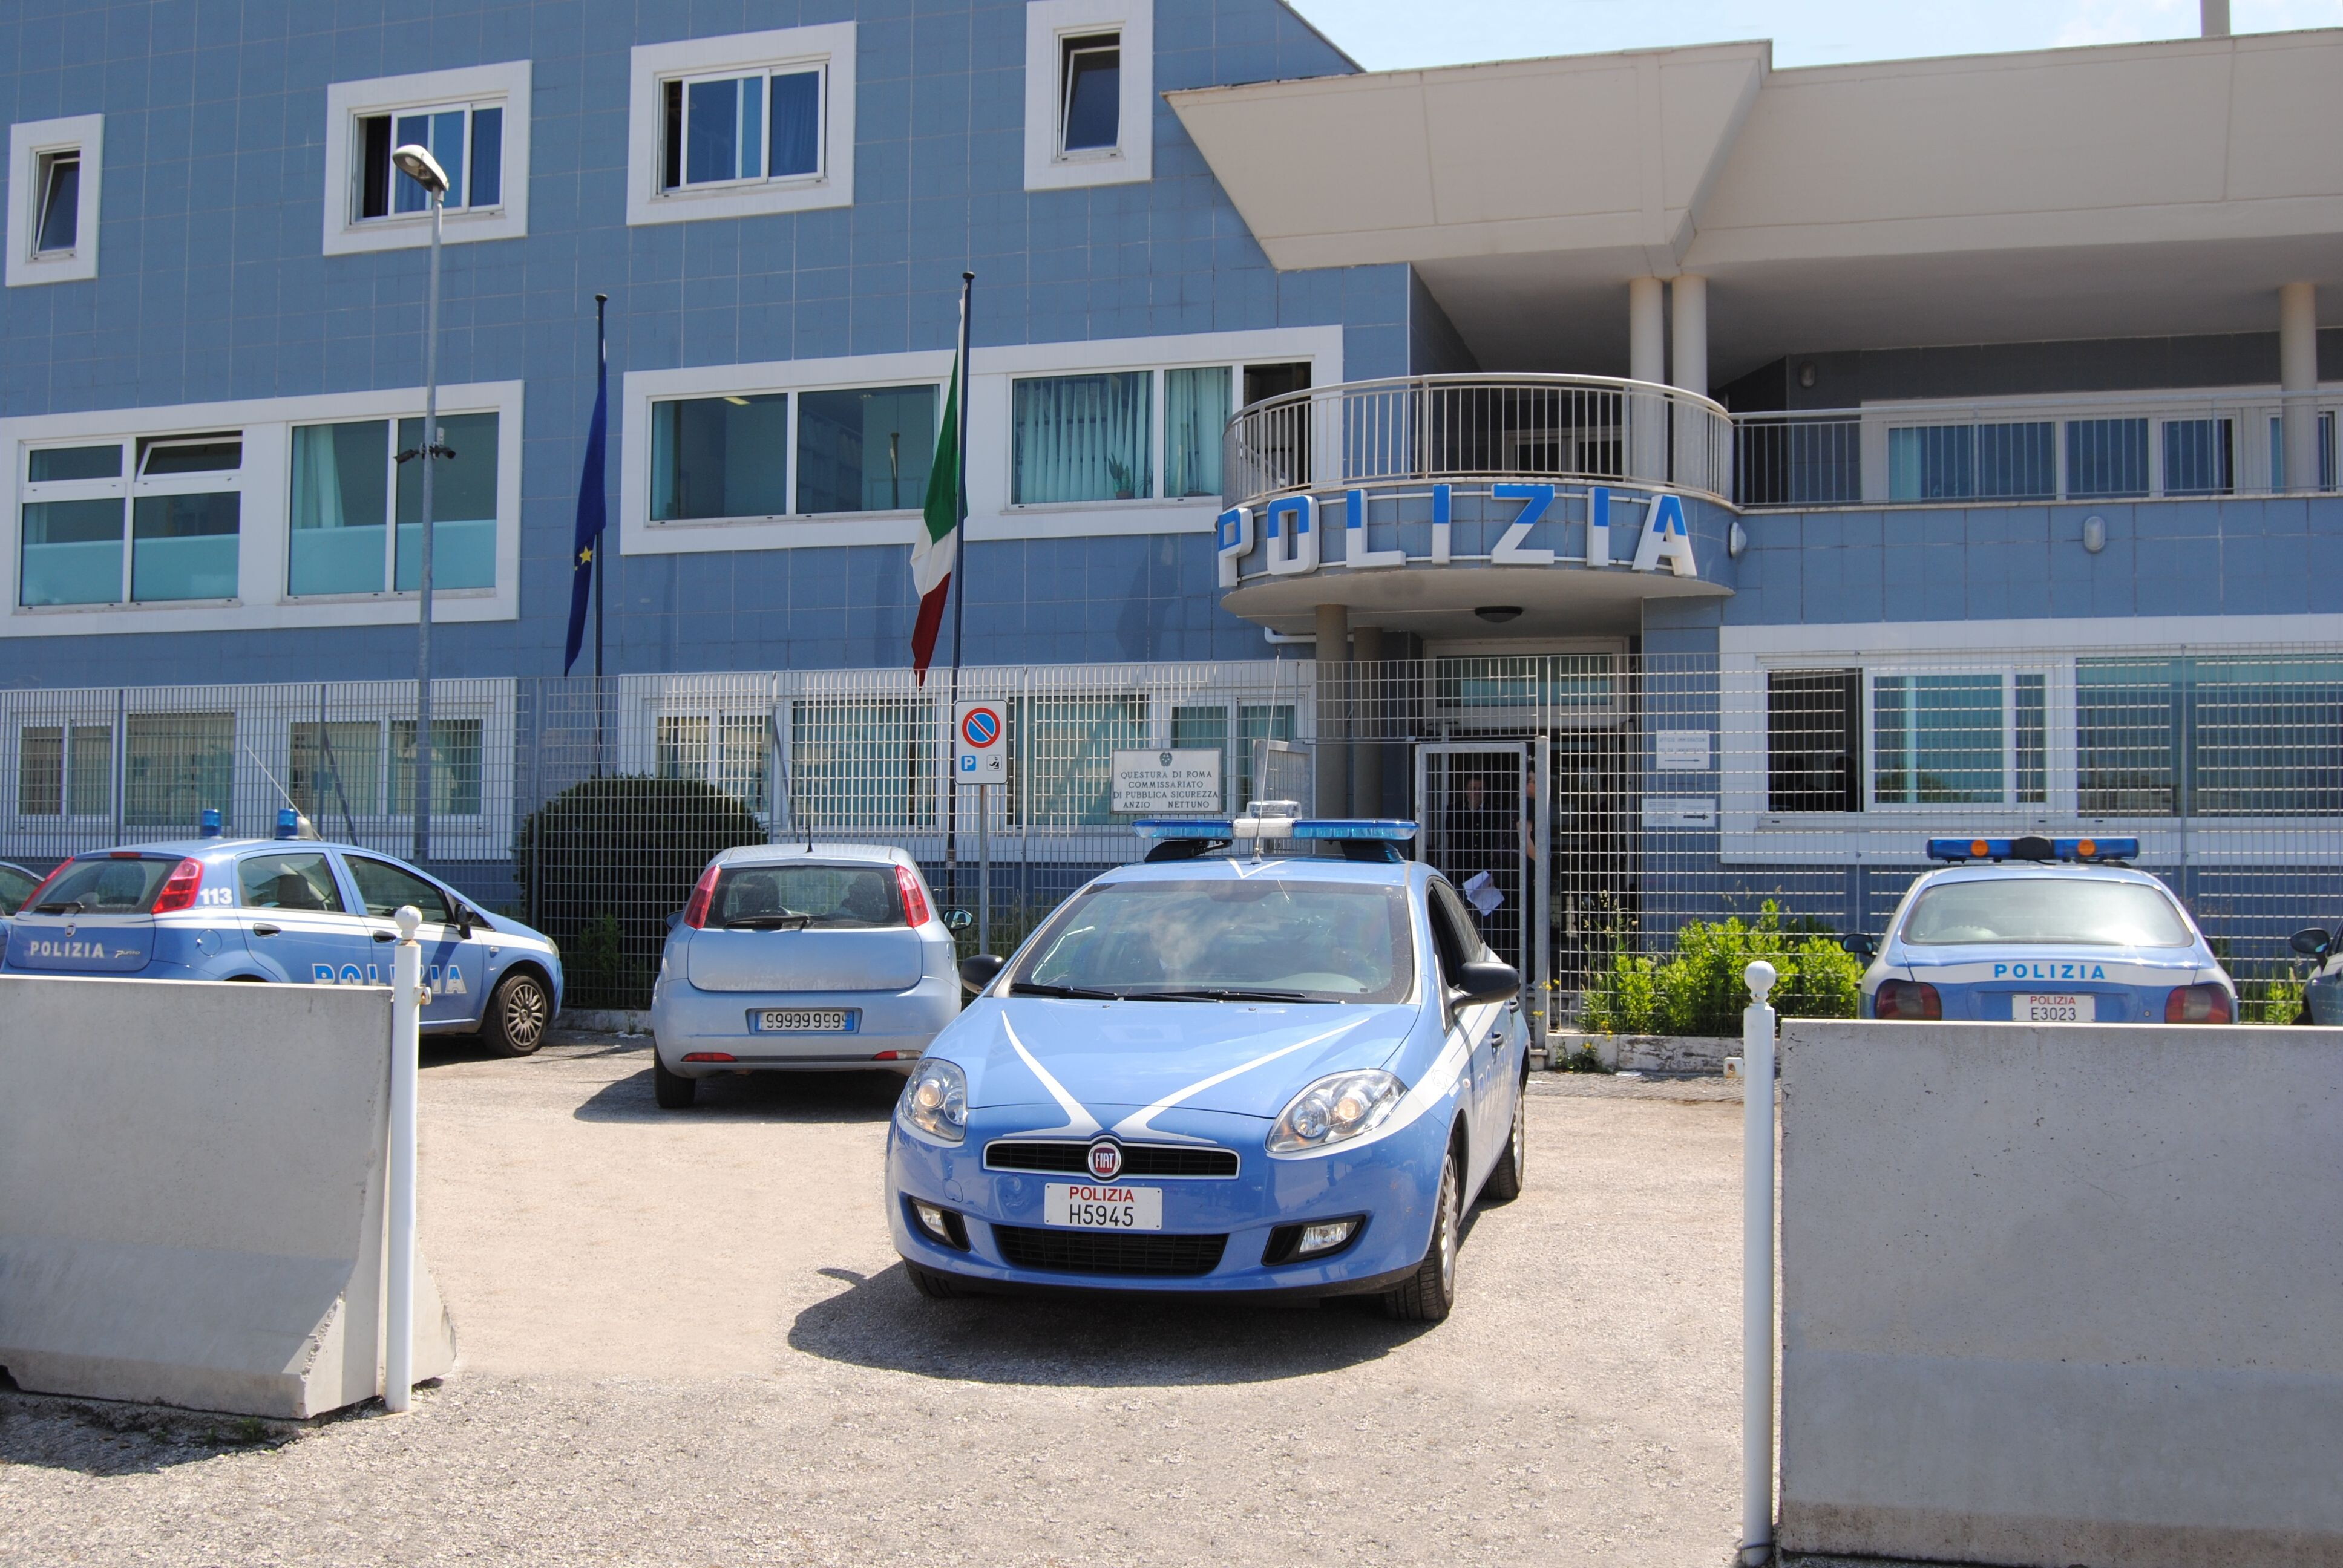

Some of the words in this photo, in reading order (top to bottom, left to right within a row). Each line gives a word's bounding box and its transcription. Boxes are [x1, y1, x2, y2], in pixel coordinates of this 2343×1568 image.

[1217, 483, 1697, 589] POLIZIA
[964, 756, 974, 770] P
[1121, 771, 1168, 779] QUESTURA
[1128, 780, 1204, 789] COMMISSARIATO
[200, 887, 233, 905] 113
[30, 940, 105, 959] POLIZIA
[312, 962, 468, 994] POLIA
[1994, 964, 2105, 979] POLIZIA
[2030, 996, 2076, 1005] POLIZIA
[2031, 1007, 2076, 1021] E3023
[1095, 1152, 1115, 1169] FIAT
[1069, 1186, 1135, 1203] POLIZIA
[1069, 1203, 1134, 1227] H5945
